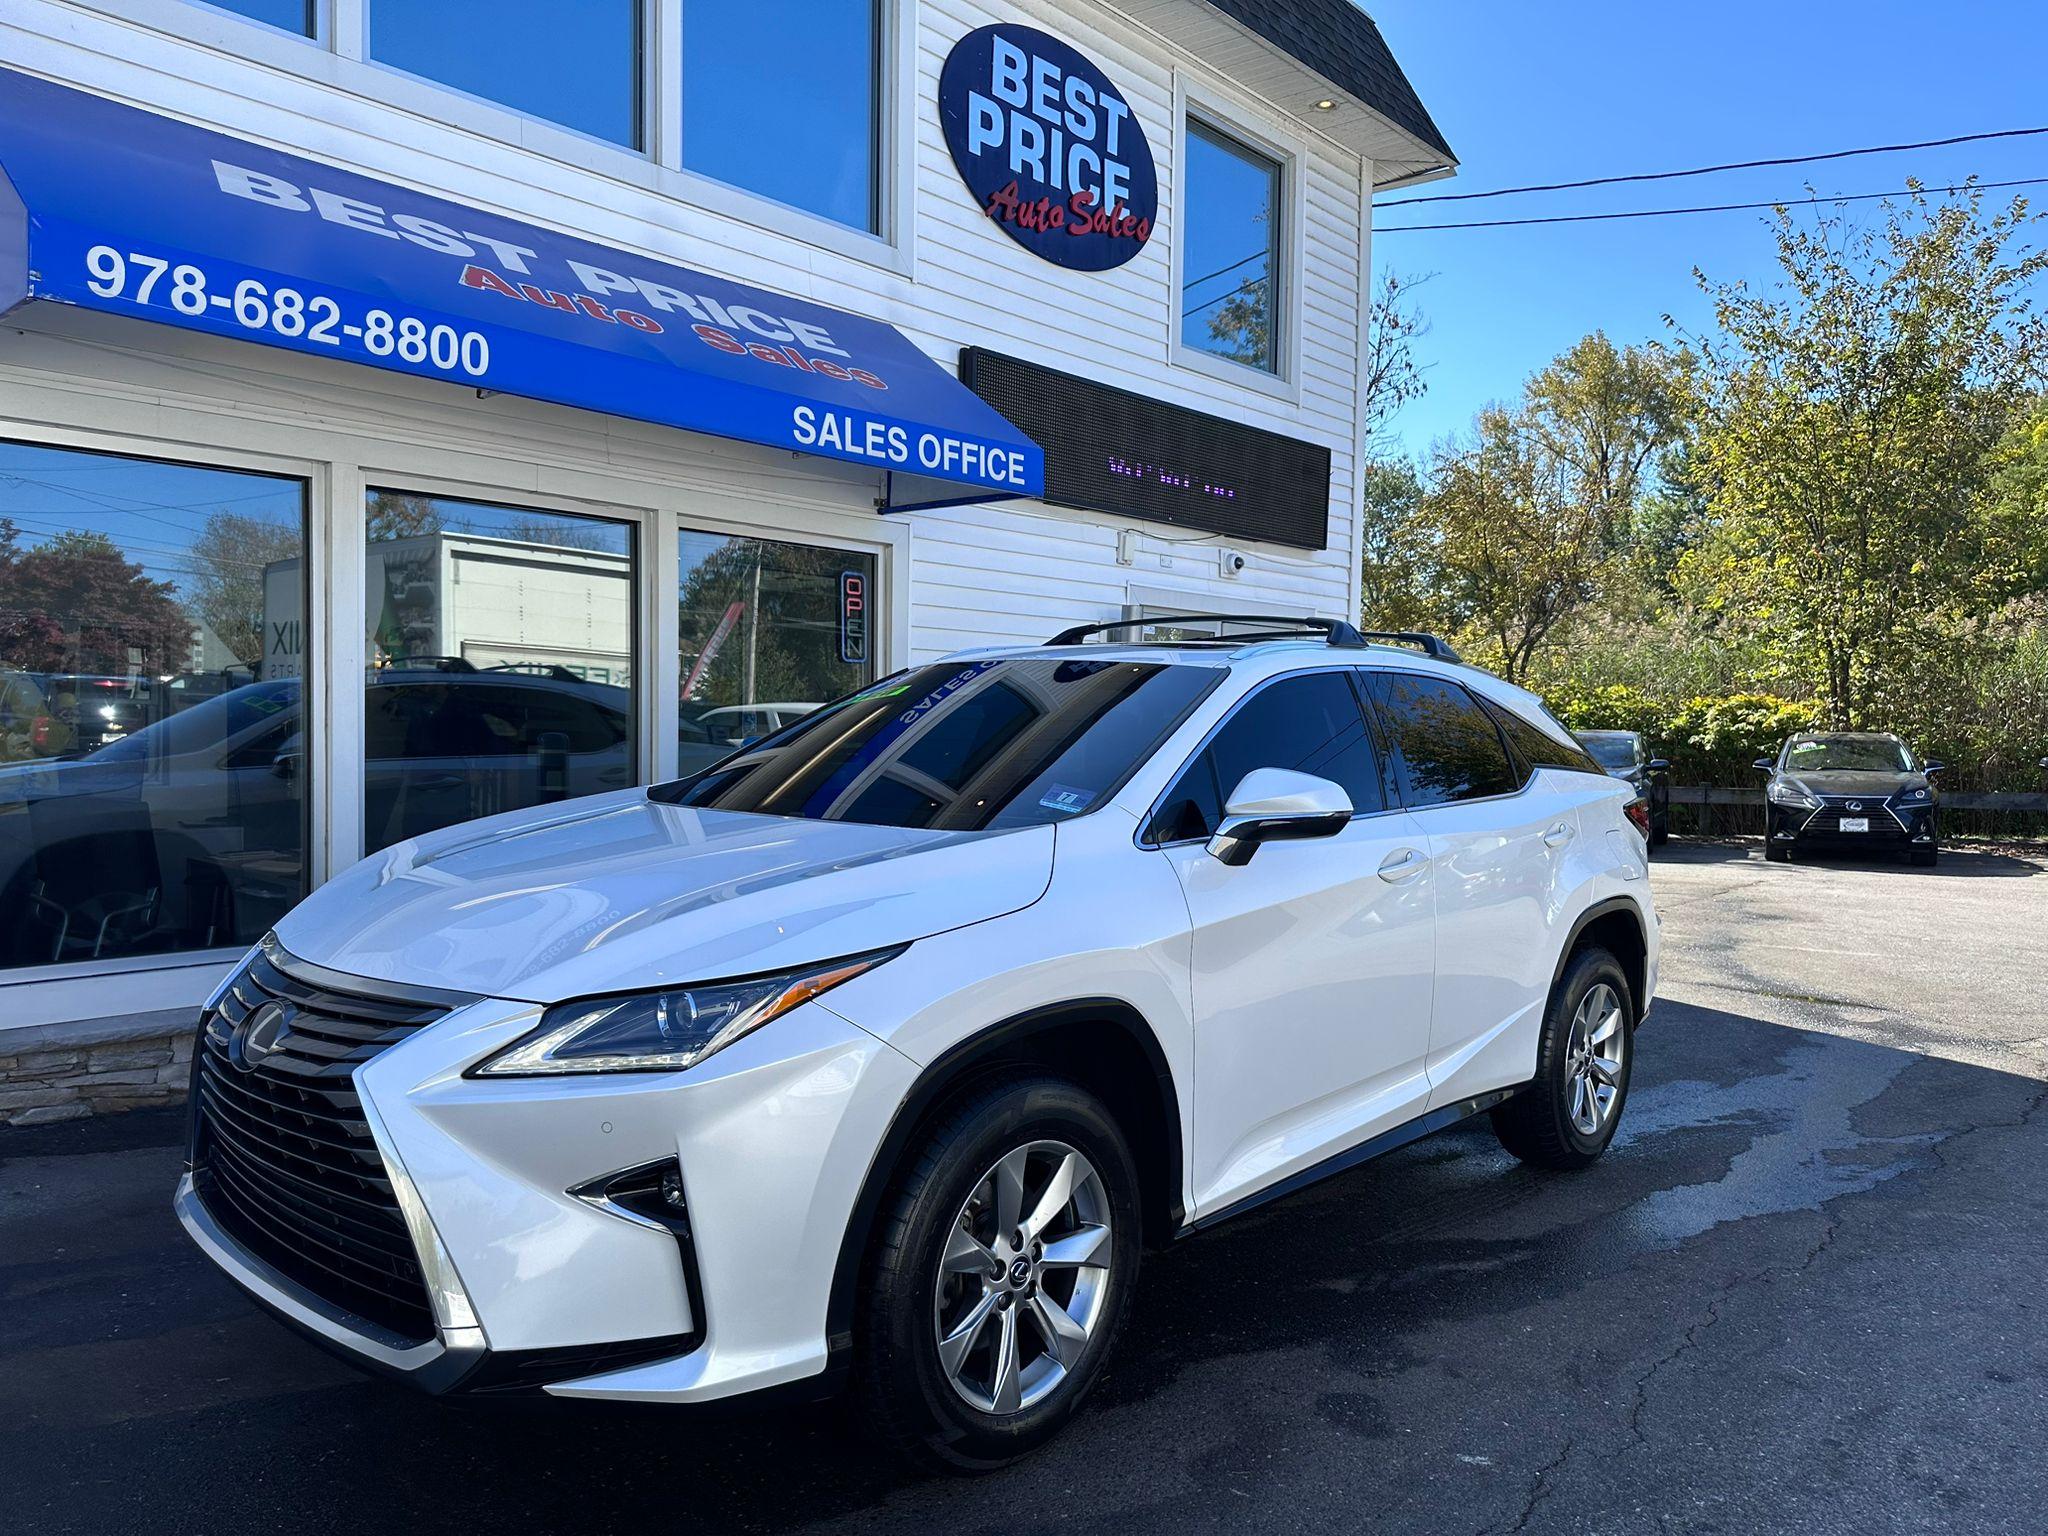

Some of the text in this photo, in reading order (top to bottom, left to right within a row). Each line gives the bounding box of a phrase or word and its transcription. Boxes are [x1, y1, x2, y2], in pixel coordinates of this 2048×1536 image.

[968, 90, 1130, 220] PRICE
[992, 34, 1128, 156] BEST
[210, 159, 852, 358] BEST PRICE
[986, 180, 1150, 241] Auto Sales
[86, 245, 490, 376] 978-682-8800
[457, 263, 889, 391] Auto Sales
[792, 405, 1026, 486] SALES OFFICE
[846, 578, 863, 657] OPEN
